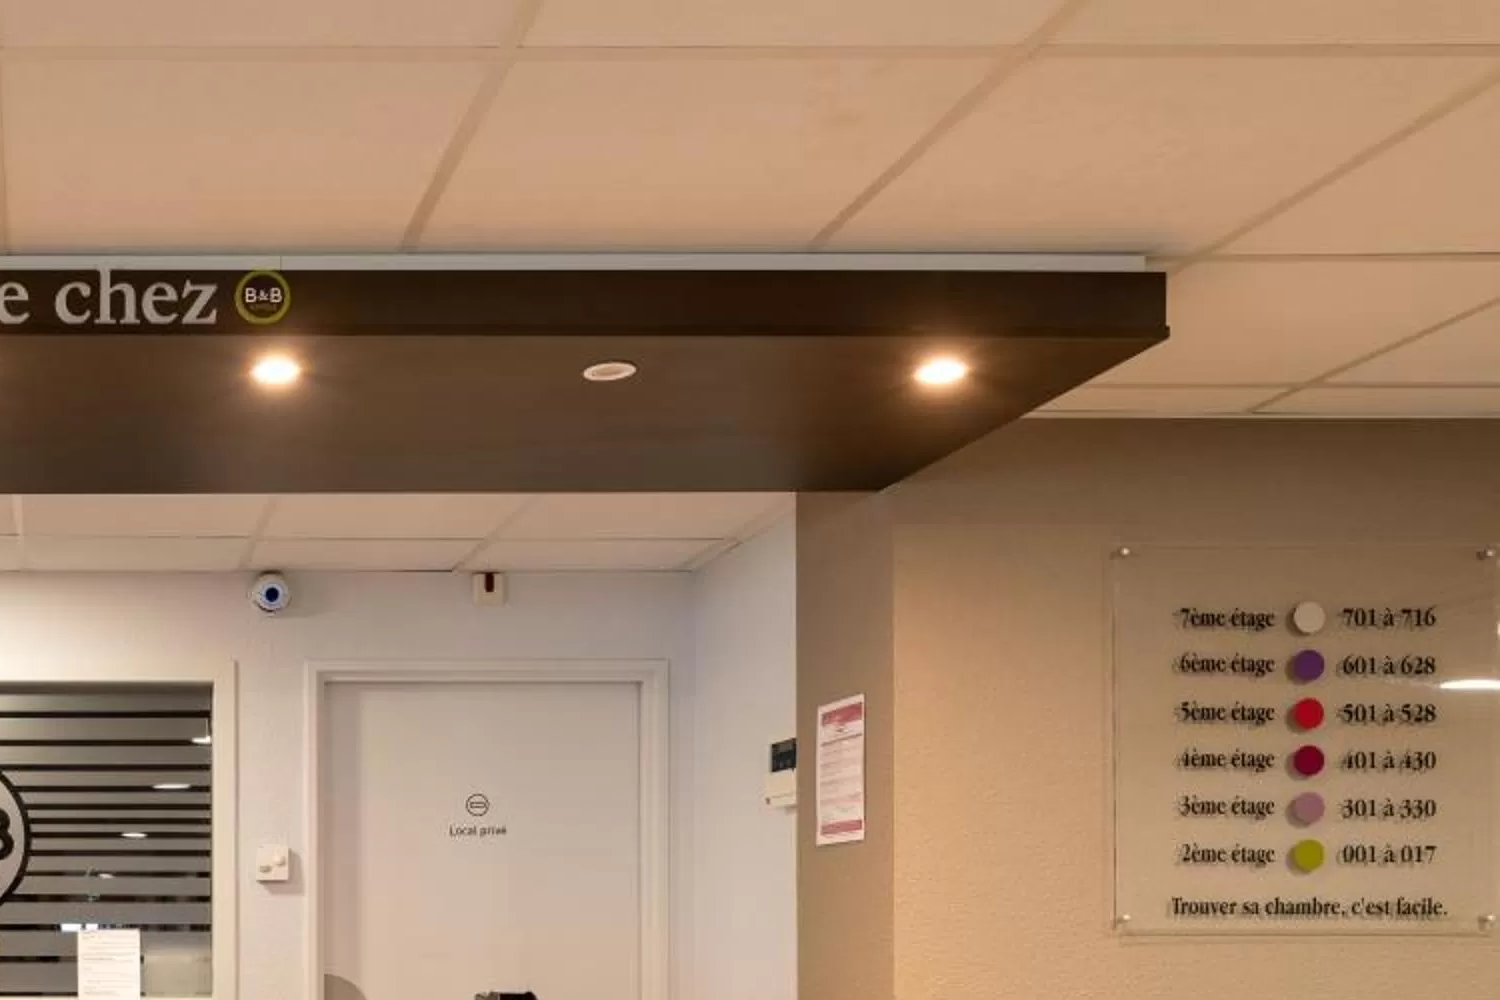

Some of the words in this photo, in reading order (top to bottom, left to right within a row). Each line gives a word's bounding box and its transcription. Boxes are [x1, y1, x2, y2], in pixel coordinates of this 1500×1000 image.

[54, 265, 218, 324] chez
[245, 287, 283, 303] B&B
[1179, 608, 1225, 628] 7ème
[1231, 608, 1276, 630] étage
[1342, 608, 1376, 627] 701
[1383, 606, 1395, 627] à
[1400, 608, 1437, 627] 716
[1179, 653, 1225, 673] 6ème
[1231, 653, 1276, 676] étage
[1342, 655, 1376, 674] 601
[1383, 653, 1395, 674] à
[1400, 655, 1437, 674] 628
[1179, 701, 1225, 721] 5ème
[1231, 701, 1276, 725] étage
[1342, 703, 1376, 722] 501
[1383, 701, 1395, 722] à
[1400, 703, 1437, 722] 528
[1179, 749, 1225, 768] 4ème
[1231, 748, 1276, 772] étage
[1342, 751, 1376, 769] 401
[1383, 749, 1395, 769] à
[1400, 751, 1437, 769] 430
[1179, 796, 1225, 816] 3ème
[1231, 796, 1276, 820] étage
[1342, 799, 1376, 818] 301
[1383, 797, 1395, 818] à
[1400, 799, 1437, 818] 330
[449, 824, 476, 837] Local
[1179, 843, 1225, 863] 2ème
[1231, 843, 1276, 867] étage
[1342, 845, 1376, 863] 001
[1383, 843, 1395, 863] à
[1400, 845, 1437, 863] 017
[1172, 897, 1237, 915] Trouver
[1243, 903, 1260, 915] sa
[1265, 897, 1345, 917] chambre,
[1351, 897, 1390, 915] c'est
